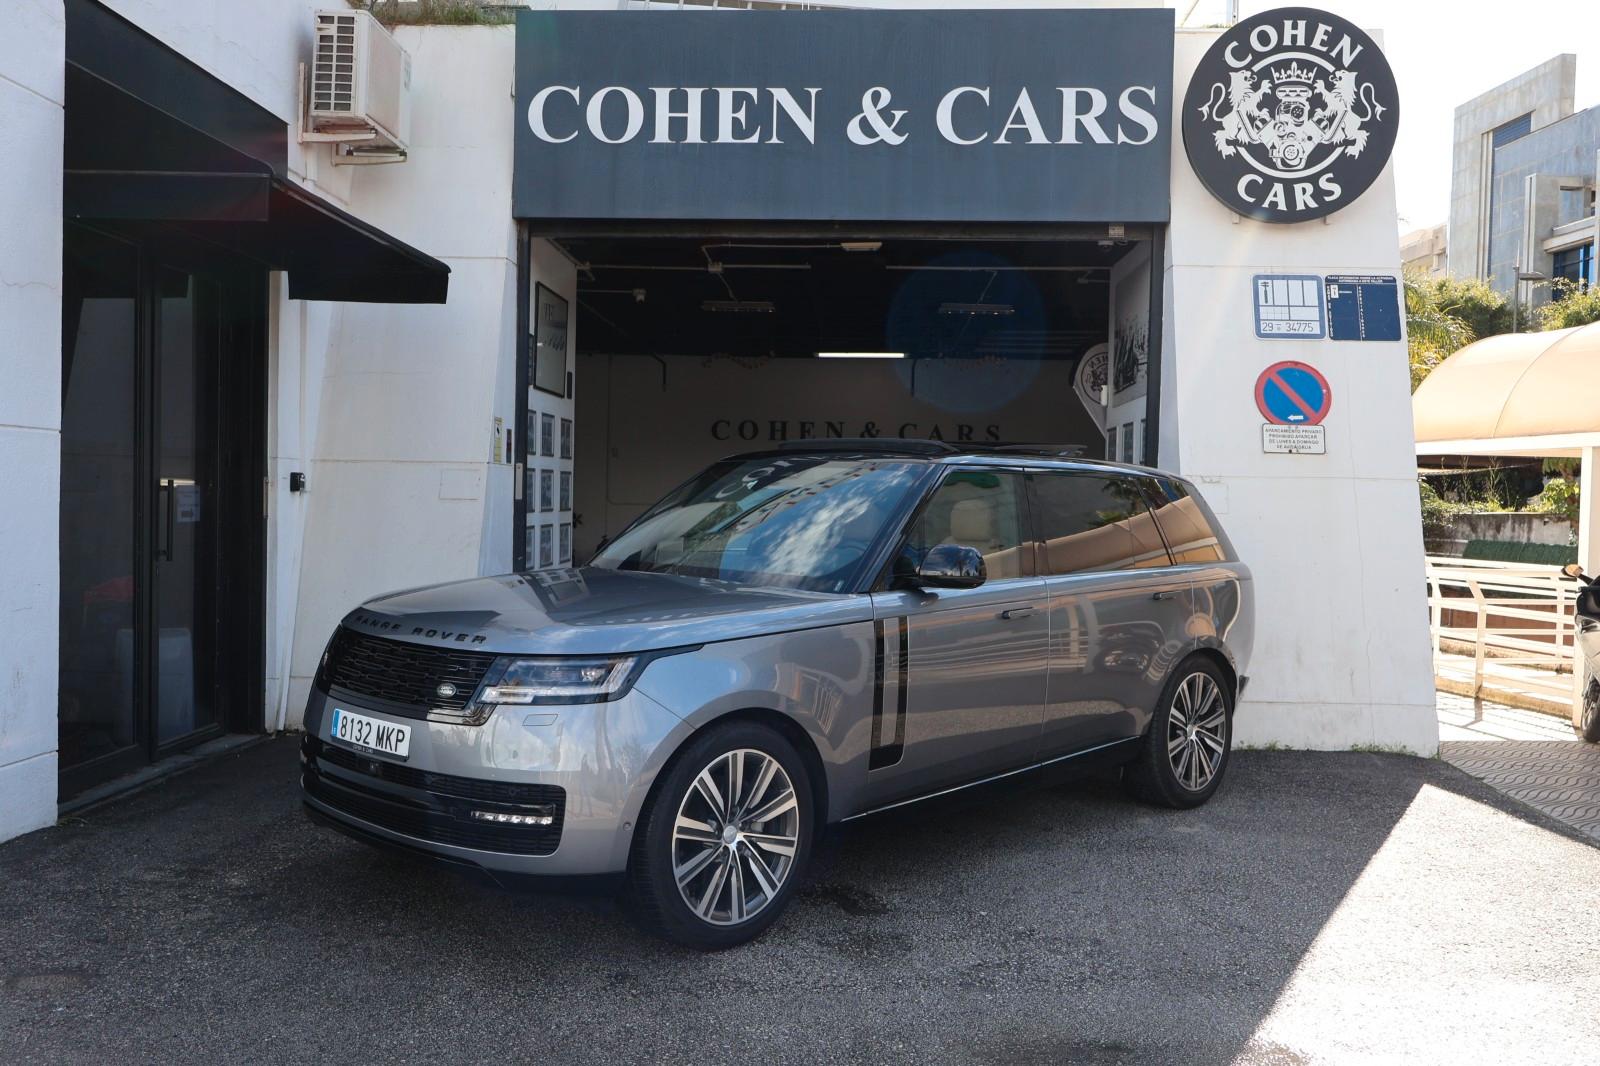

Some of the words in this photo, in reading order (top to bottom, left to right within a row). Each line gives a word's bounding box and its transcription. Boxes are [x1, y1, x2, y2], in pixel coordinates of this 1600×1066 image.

[1224, 19, 1364, 69] COHEN
[526, 85, 823, 146] COHEN
[846, 85, 910, 147] &
[935, 85, 1160, 147] CARS
[1236, 172, 1342, 211] CARS
[1262, 322, 1274, 332] 29
[1285, 322, 1314, 332] 34775
[711, 419, 847, 441] COHEN
[898, 423, 1001, 441] CARS
[354, 615, 401, 630] RANGE
[411, 627, 487, 644] ROVER
[340, 716, 372, 745] 8132
[375, 724, 406, 752] MKP
